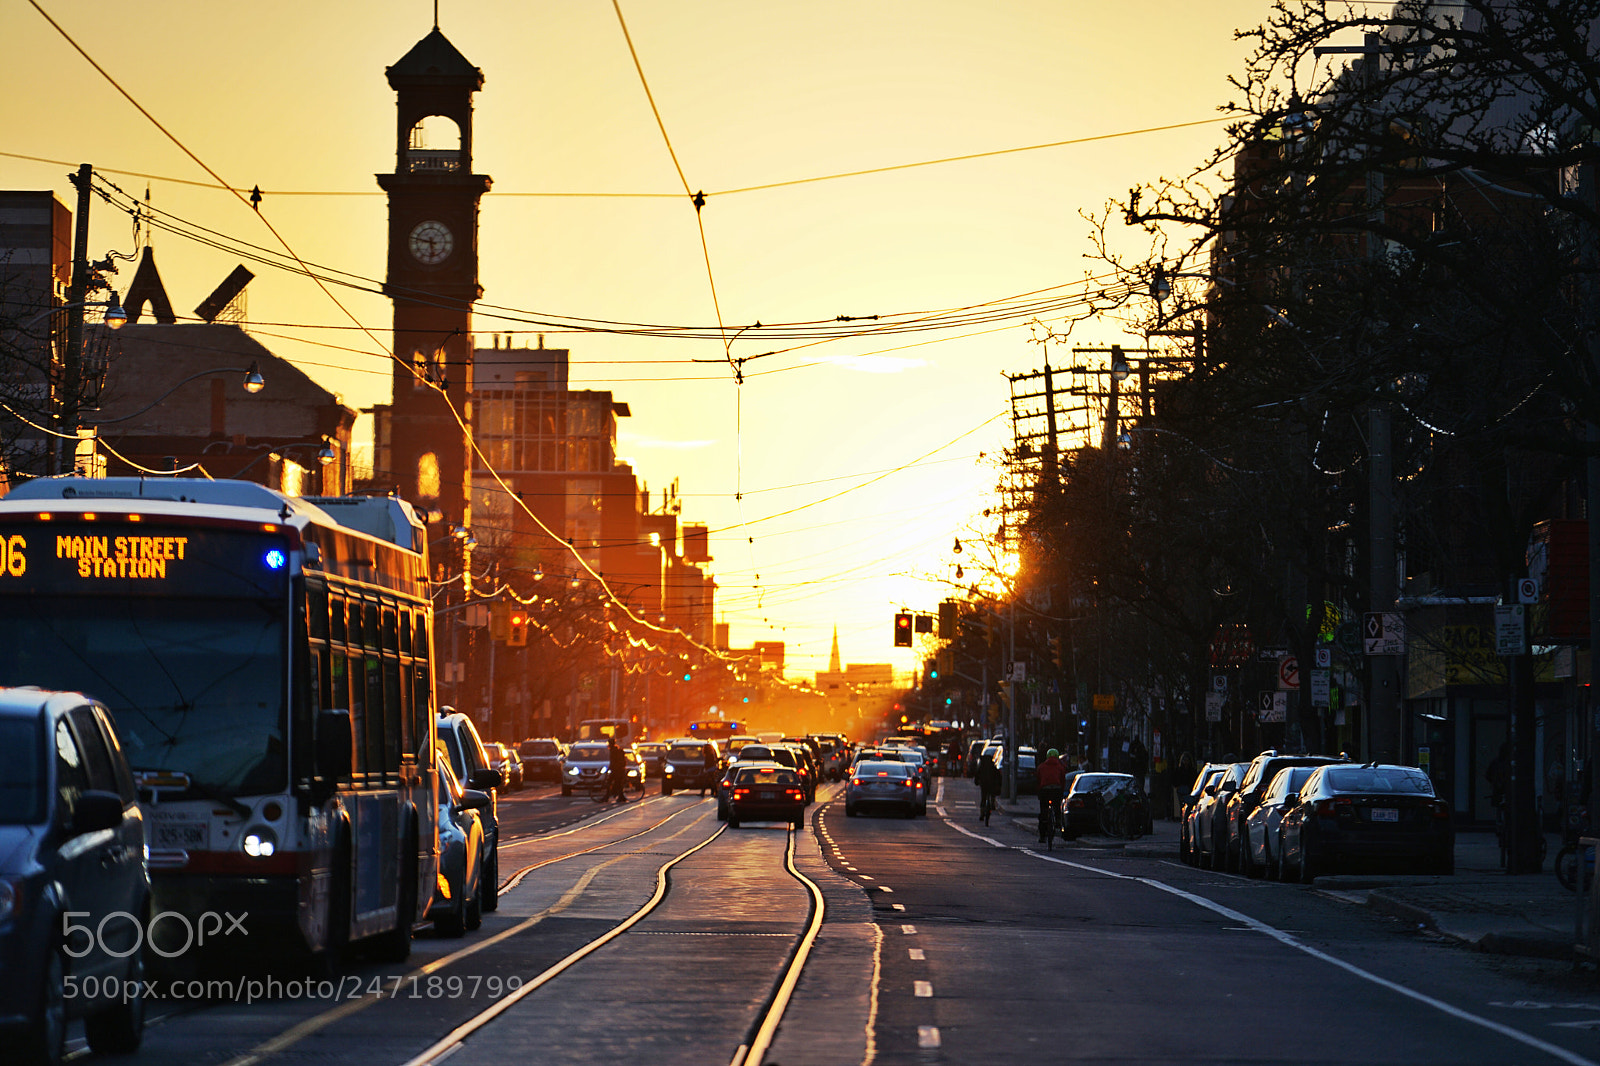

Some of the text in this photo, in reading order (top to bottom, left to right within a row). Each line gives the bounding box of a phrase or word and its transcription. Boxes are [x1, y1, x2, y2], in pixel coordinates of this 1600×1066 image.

[56, 535, 188, 560] MAIN STREET
[78, 557, 166, 578] STATION
